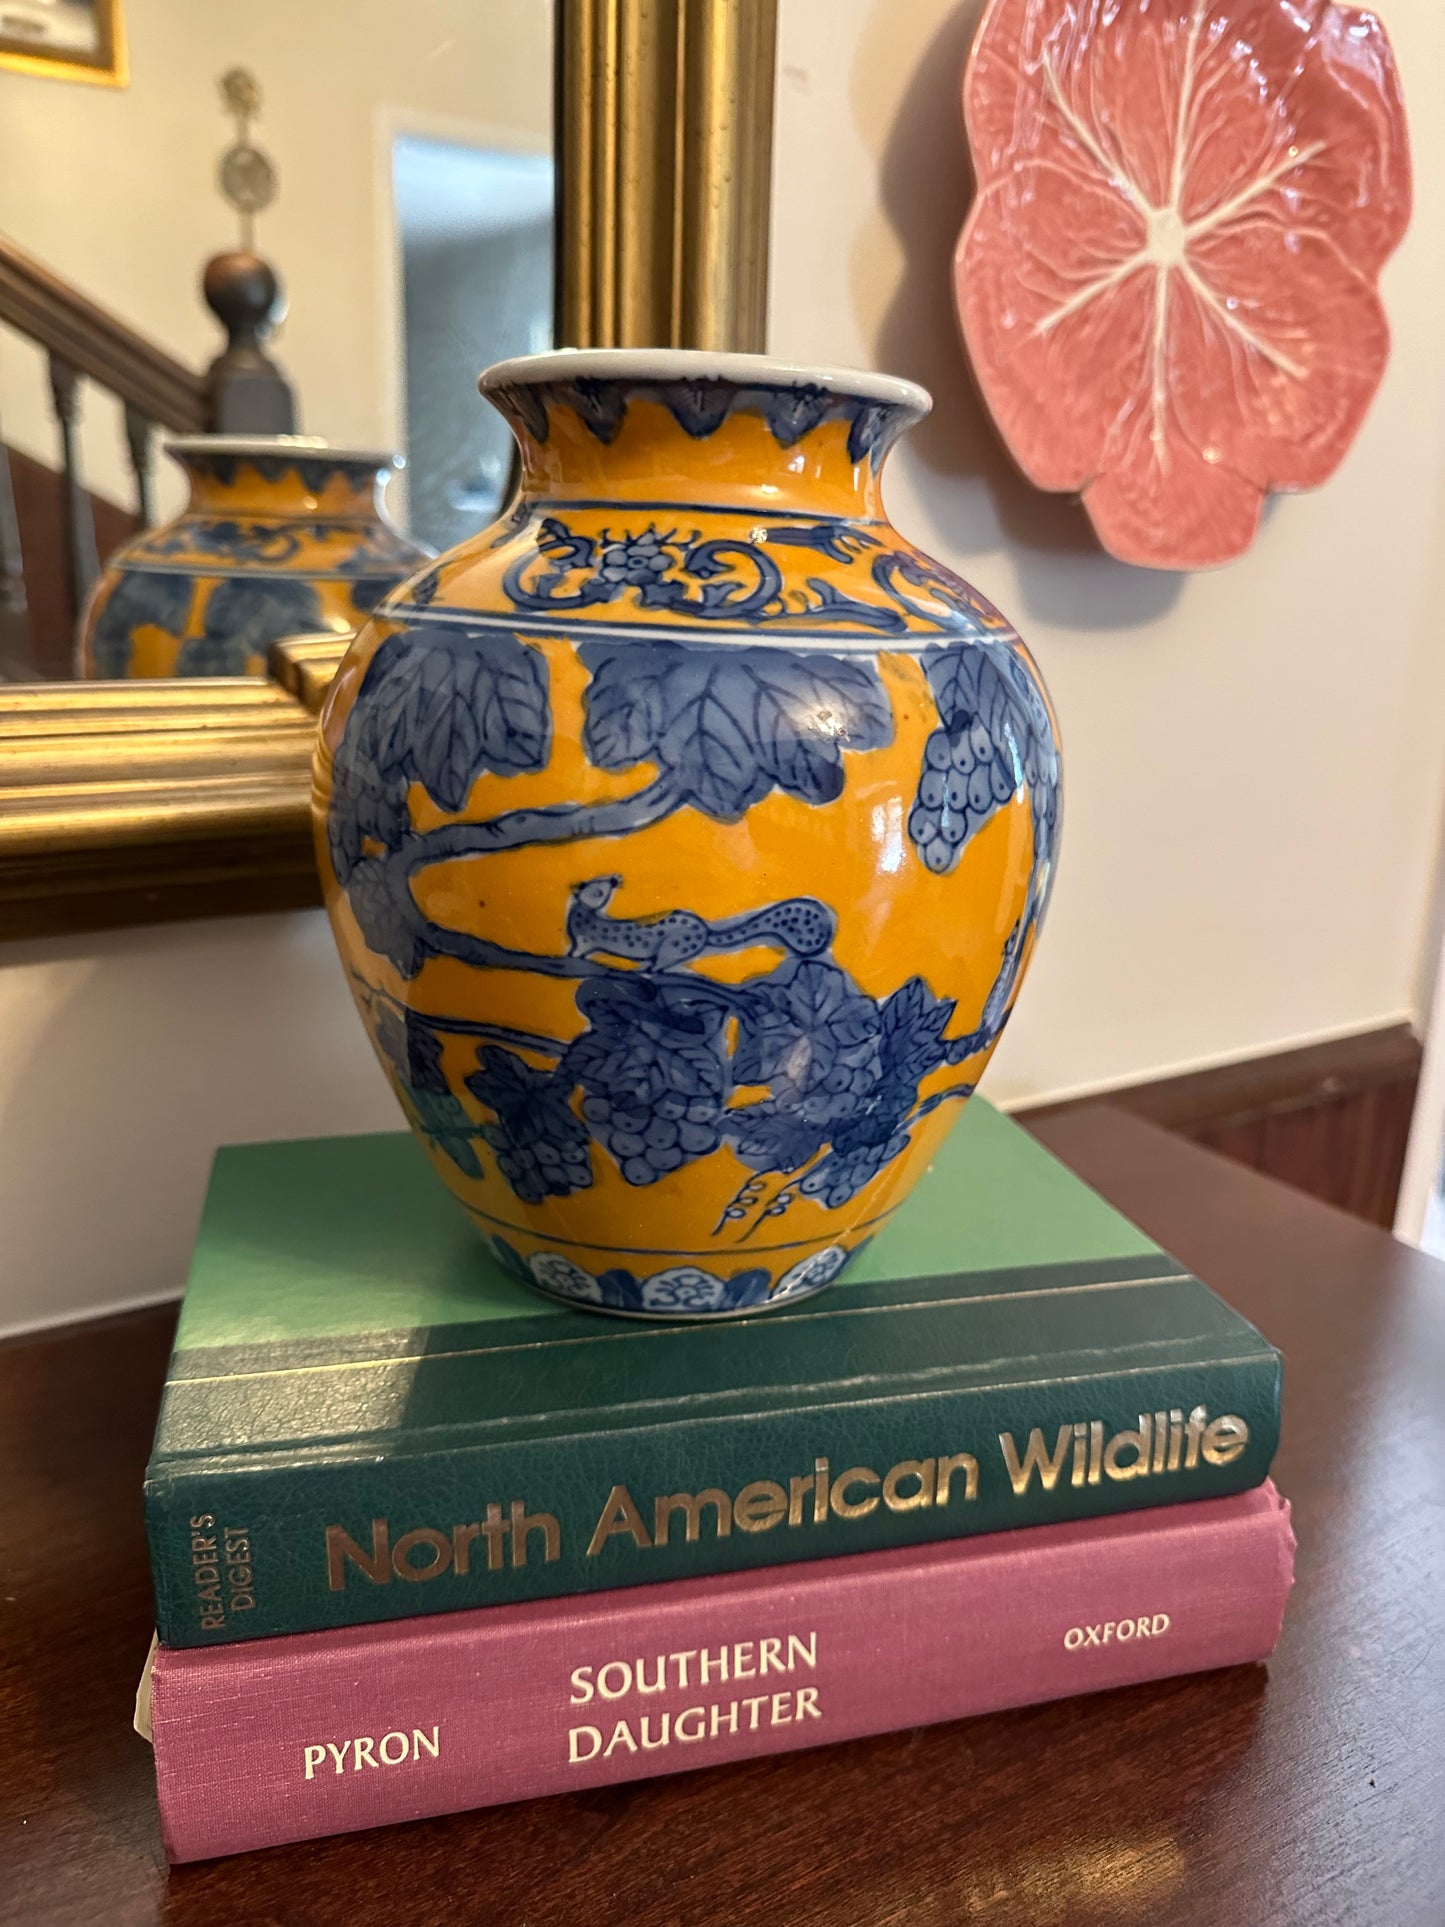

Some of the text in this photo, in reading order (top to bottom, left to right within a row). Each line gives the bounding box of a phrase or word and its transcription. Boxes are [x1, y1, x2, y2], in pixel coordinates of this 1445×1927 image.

[326, 1404, 1250, 1591] North American Wildlife
[190, 1512, 226, 1630] READER'S
[224, 1526, 256, 1611] DIGEST
[569, 1631, 818, 1705] SOUTHERN
[1063, 1613, 1171, 1652] OXFORD
[303, 1725, 441, 1780] PYRON
[567, 1686, 822, 1764] DAUGHTER
